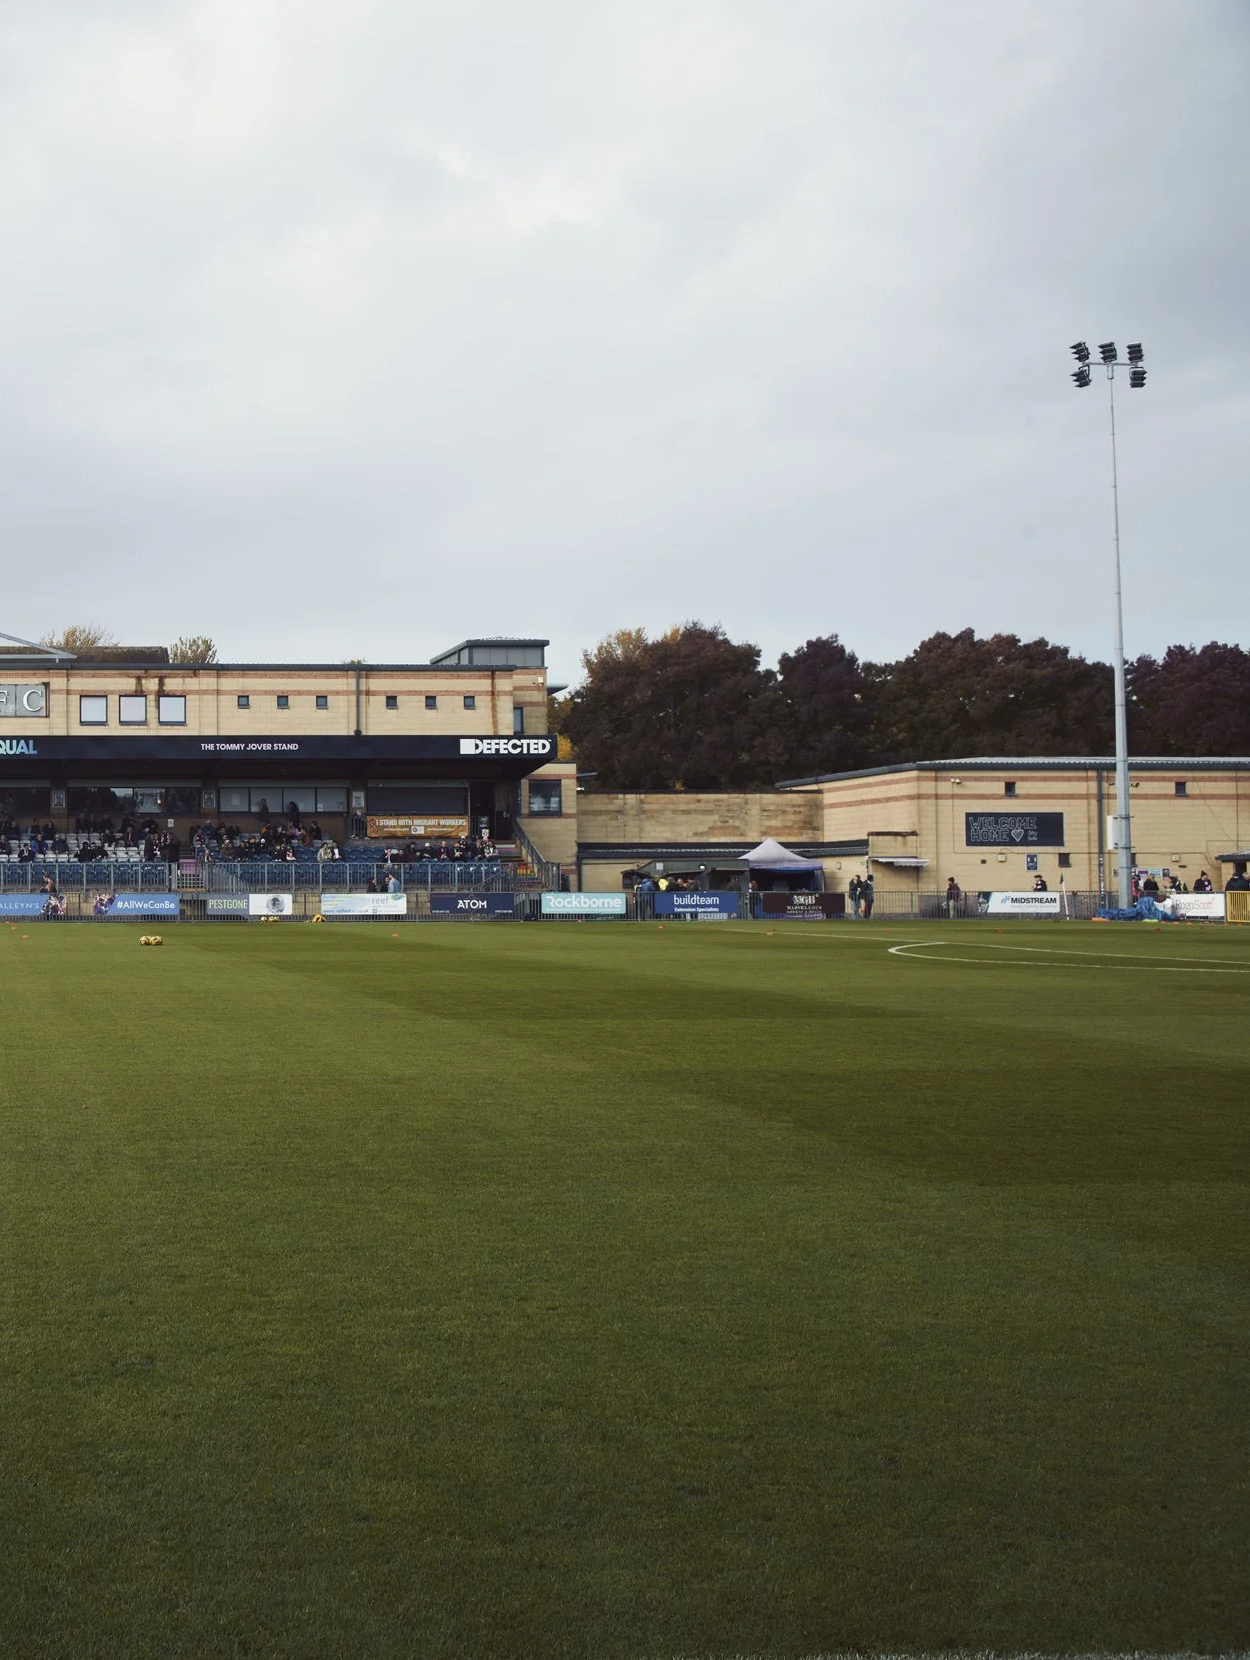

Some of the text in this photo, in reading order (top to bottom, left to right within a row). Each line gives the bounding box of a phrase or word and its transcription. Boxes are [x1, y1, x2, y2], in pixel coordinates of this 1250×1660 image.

[201, 743, 299, 751] THE TOMMY JOVER STAND
[460, 739, 551, 754] DEFECTED
[439, 818, 467, 826] WORKERS
[969, 816, 1037, 829] WELCOME
[970, 829, 1010, 842] HOME
[117, 901, 175, 909] #AllWeCanBe
[209, 899, 248, 909] PESTGONE
[457, 900, 487, 908] ATOM
[546, 894, 622, 908] Rockborne
[673, 894, 720, 905] buildteam
[1175, 899, 1214, 912] RogoScott
